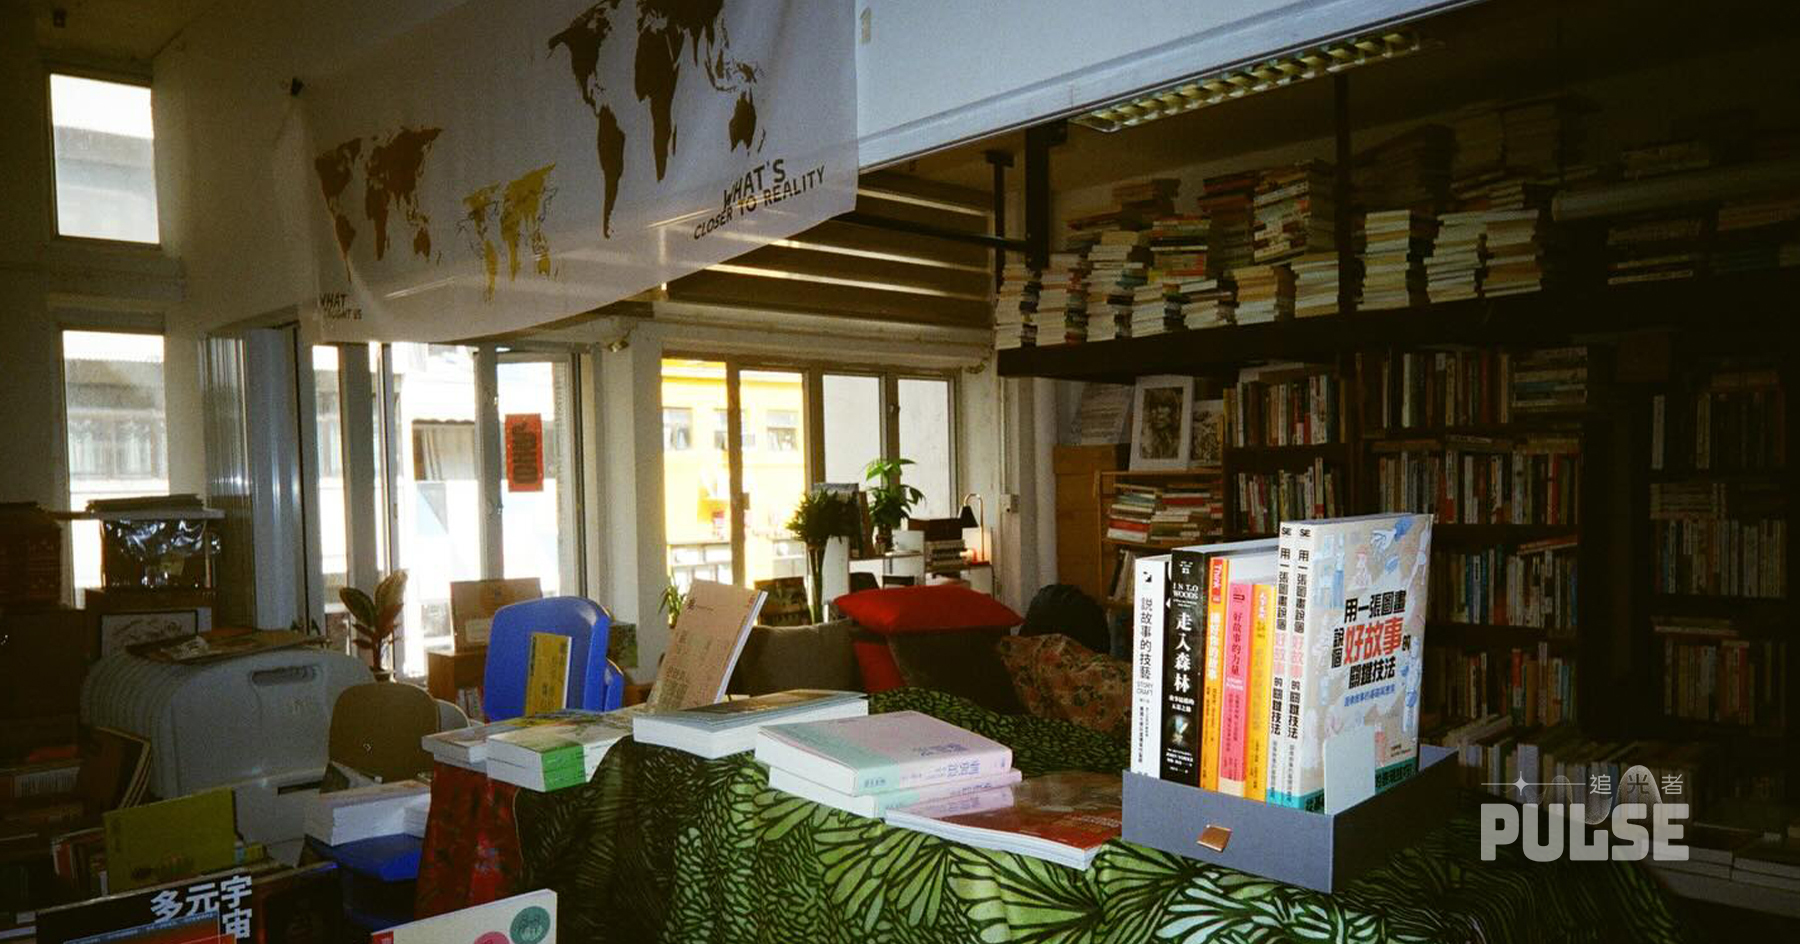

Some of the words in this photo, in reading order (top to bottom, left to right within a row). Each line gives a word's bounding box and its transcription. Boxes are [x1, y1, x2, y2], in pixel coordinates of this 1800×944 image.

[693, 207, 733, 240] CLOSER
[737, 195, 758, 216] TO
[763, 165, 826, 207] REALITY
[723, 158, 786, 210] WHAT'S
[1344, 590, 1407, 623] 用一張圖畫
[1174, 611, 1193, 693] 走入森林
[1231, 612, 1242, 676] 好故事的力量
[1349, 656, 1396, 689] 關鍵技法
[151, 874, 253, 939] 多元宇宙
